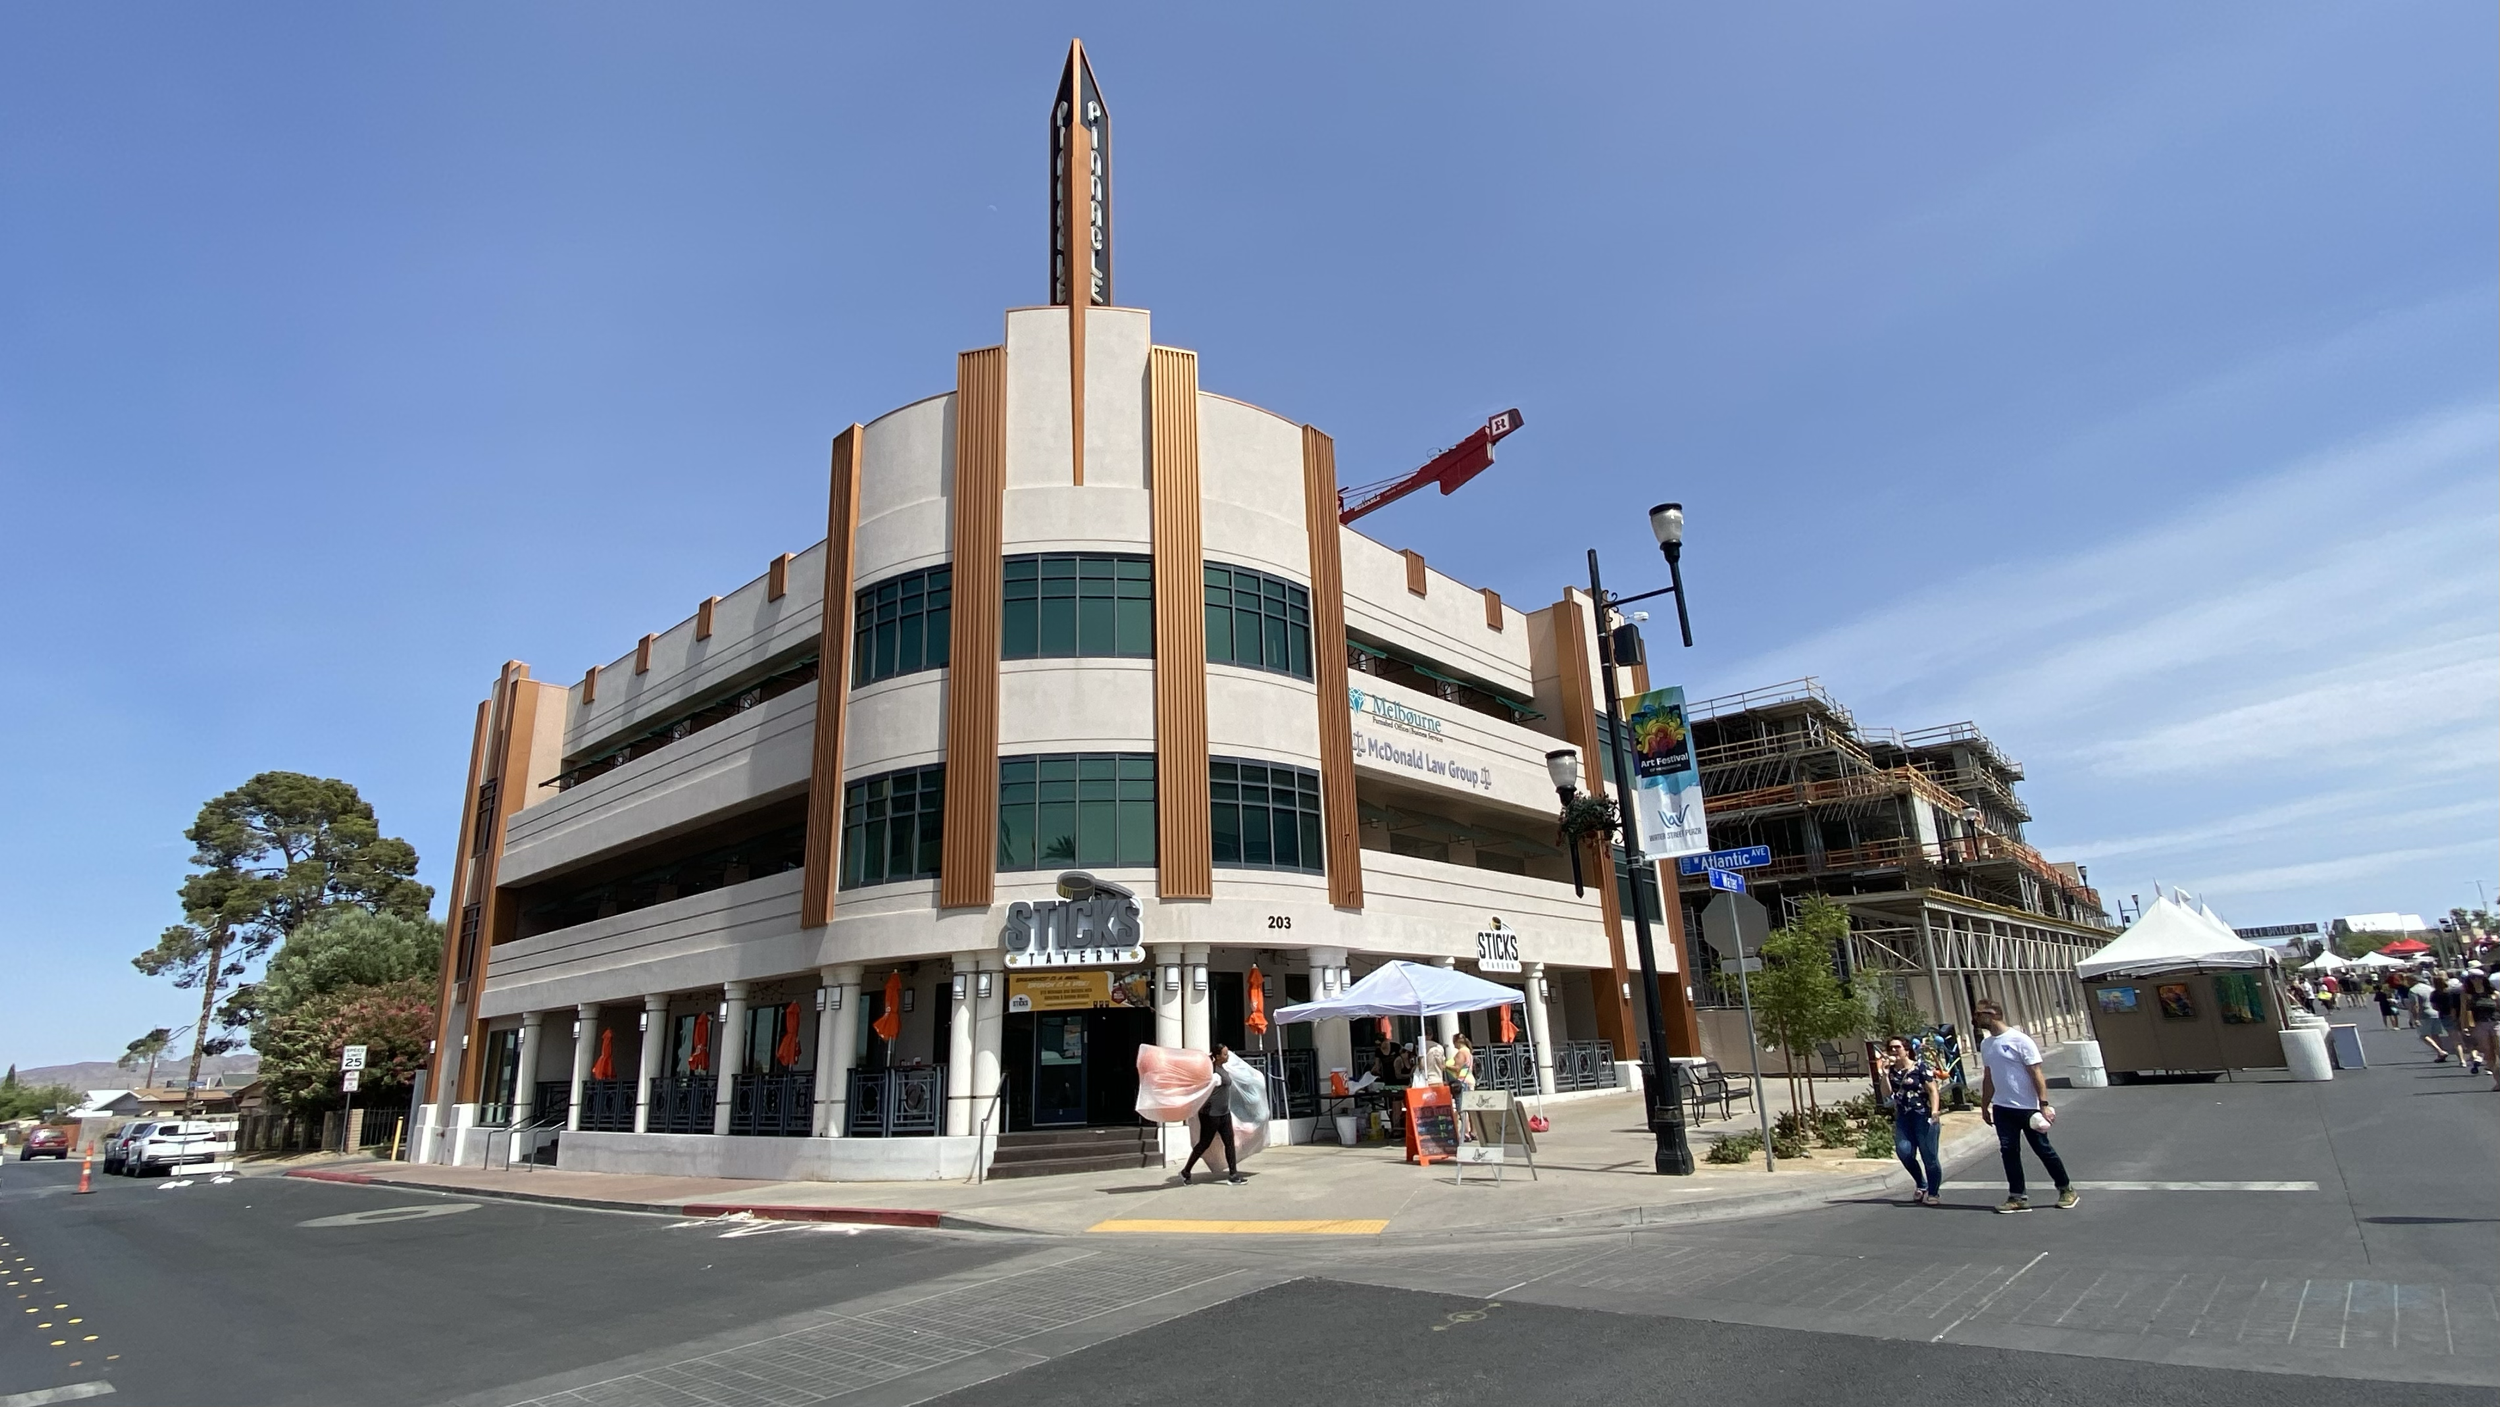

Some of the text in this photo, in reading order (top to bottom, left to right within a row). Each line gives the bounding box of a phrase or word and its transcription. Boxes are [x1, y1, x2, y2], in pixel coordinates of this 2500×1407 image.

[1087, 101, 1103, 304] PINNACLE
[1495, 418, 1506, 431] R
[1368, 738, 1479, 788] McDonald Law Group
[1641, 752, 1689, 768] Art Festival
[1649, 832, 1666, 842] WATER
[1667, 830, 1684, 839] STREET
[1701, 851, 1750, 870] Atlantic
[1751, 848, 1766, 857] AVE
[1007, 899, 1140, 949] STICKS
[1267, 915, 1291, 929] 203
[2235, 928, 2263, 938] TREET
[2267, 925, 2304, 936] DISTRICT
[1478, 932, 1518, 960] STICKS
[1029, 949, 1120, 966] TAVERN
[1486, 961, 1514, 970] TAVERN
[345, 1058, 362, 1067] 25
